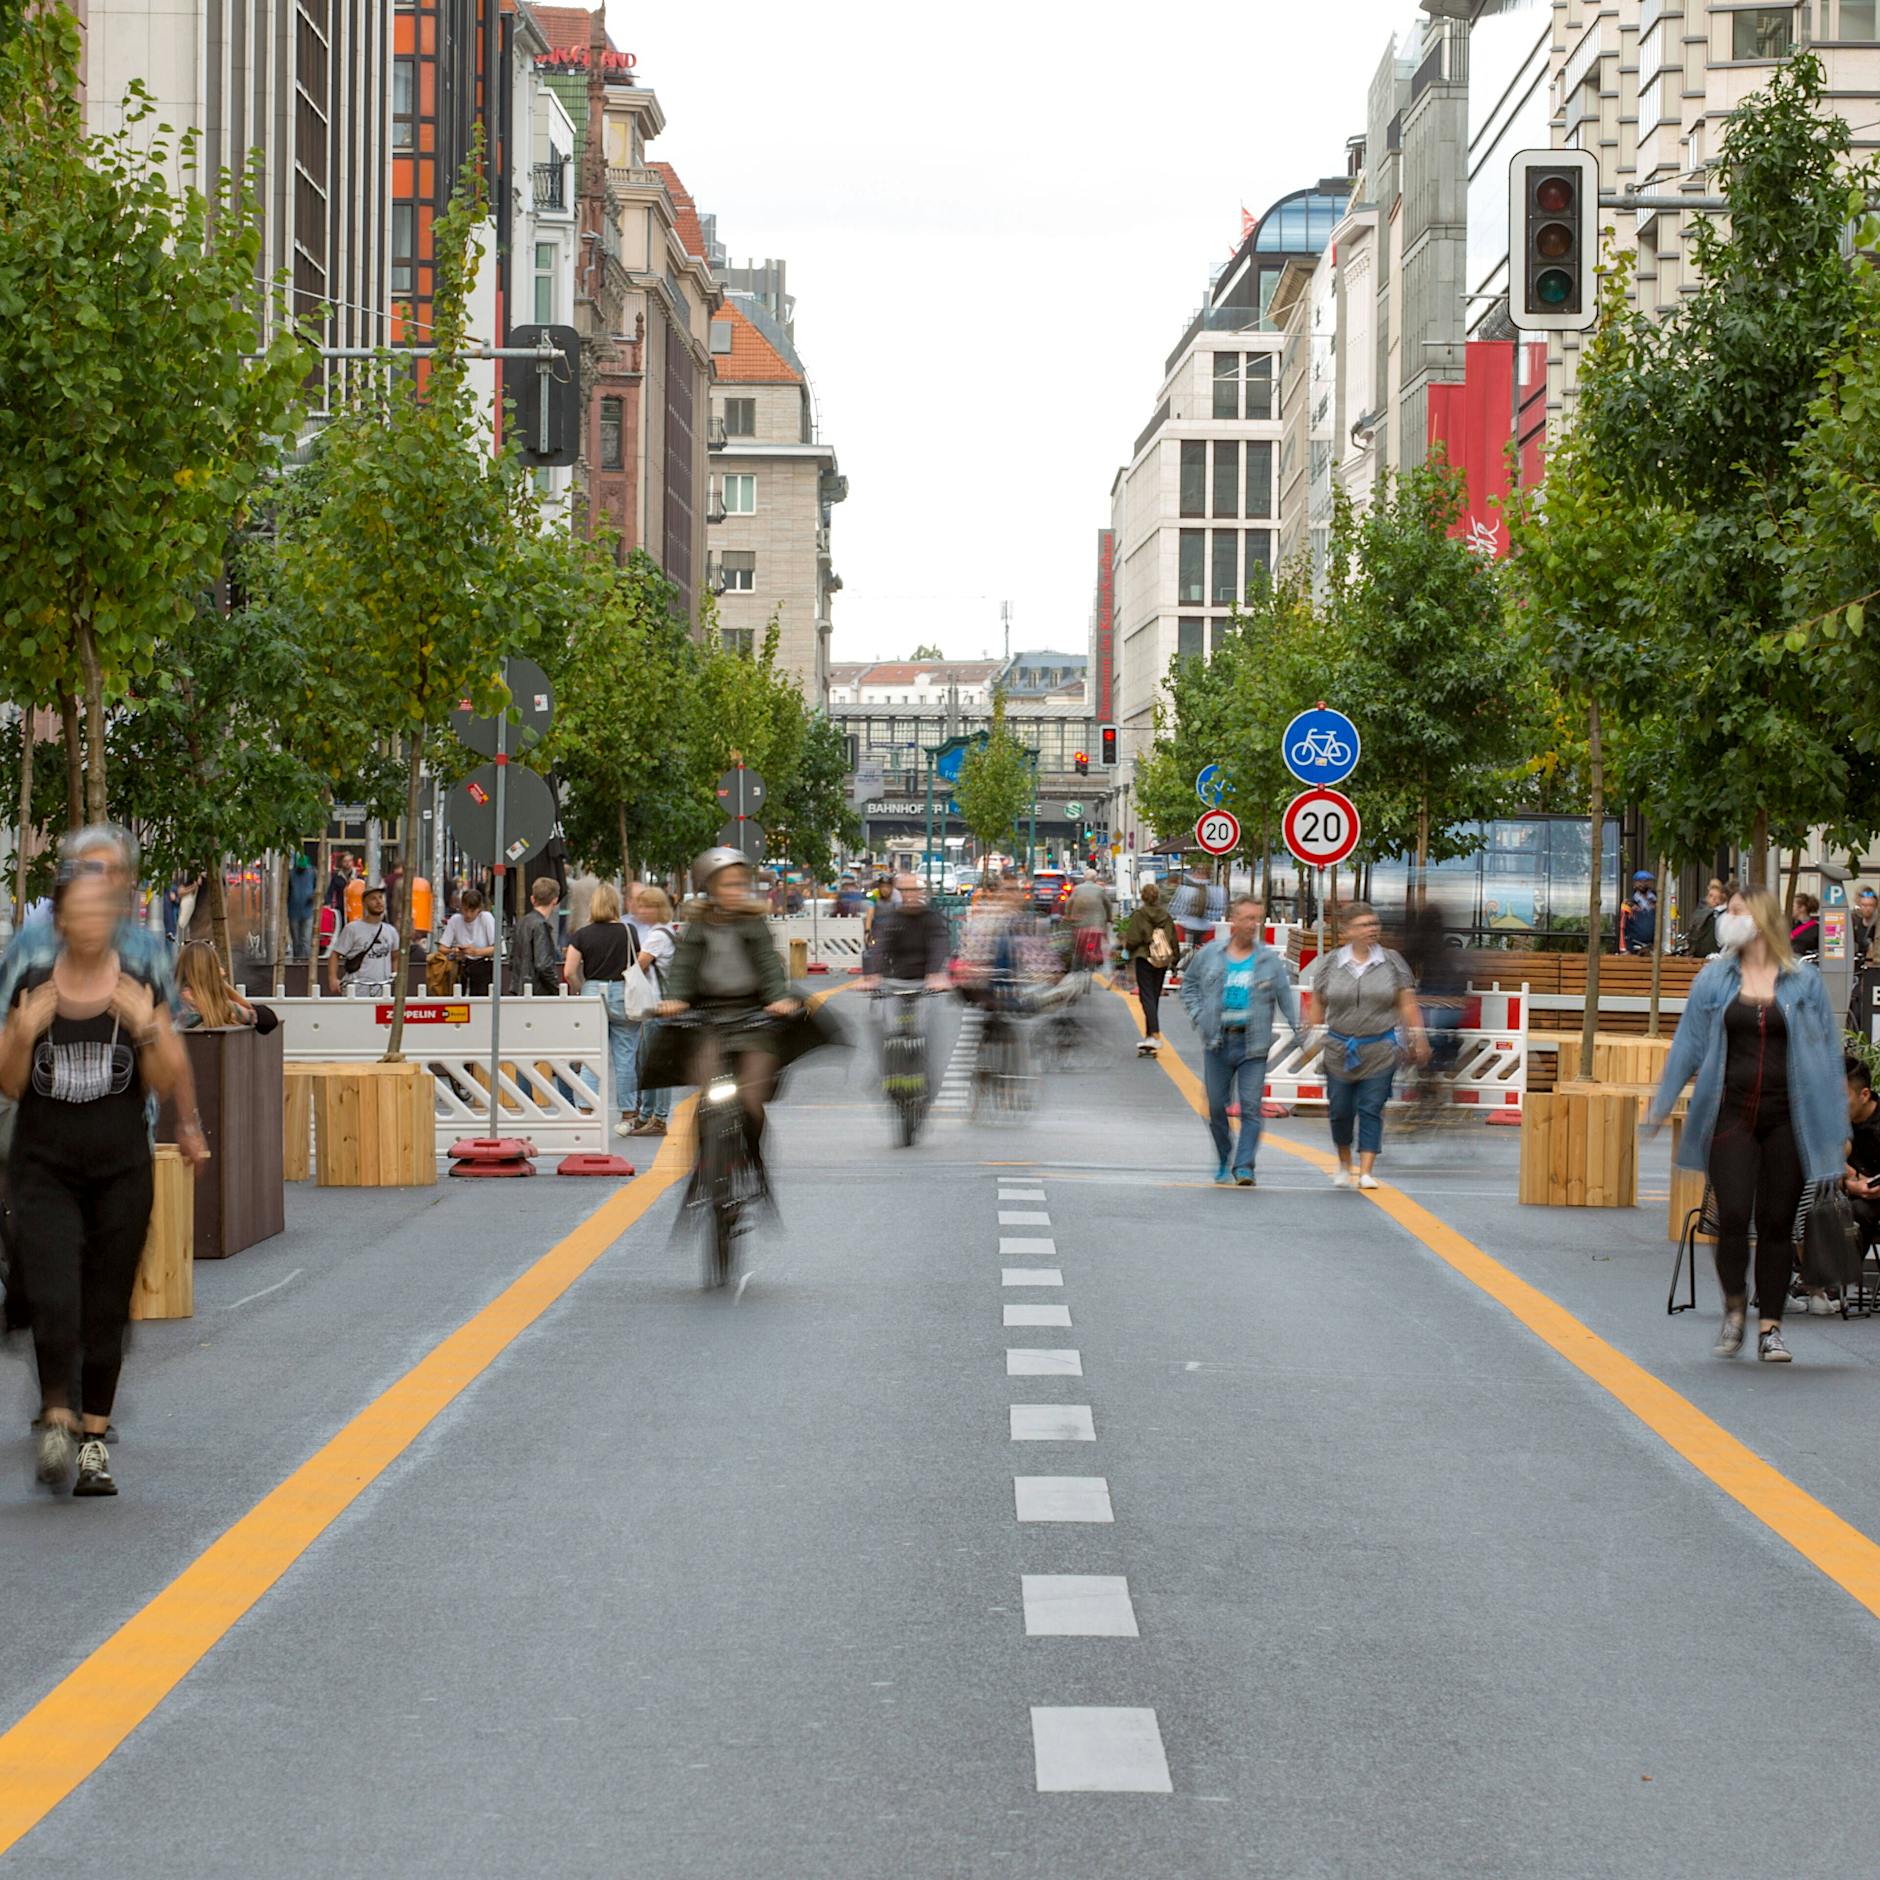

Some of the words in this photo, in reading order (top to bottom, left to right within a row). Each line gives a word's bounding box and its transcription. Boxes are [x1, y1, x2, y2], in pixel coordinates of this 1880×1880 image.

[867, 803, 925, 814] BAHNHOF
[1206, 823, 1229, 841] 20
[1301, 812, 1341, 842] 20
[1830, 885, 1843, 905] P
[386, 1010, 437, 1019] ZPELIN
